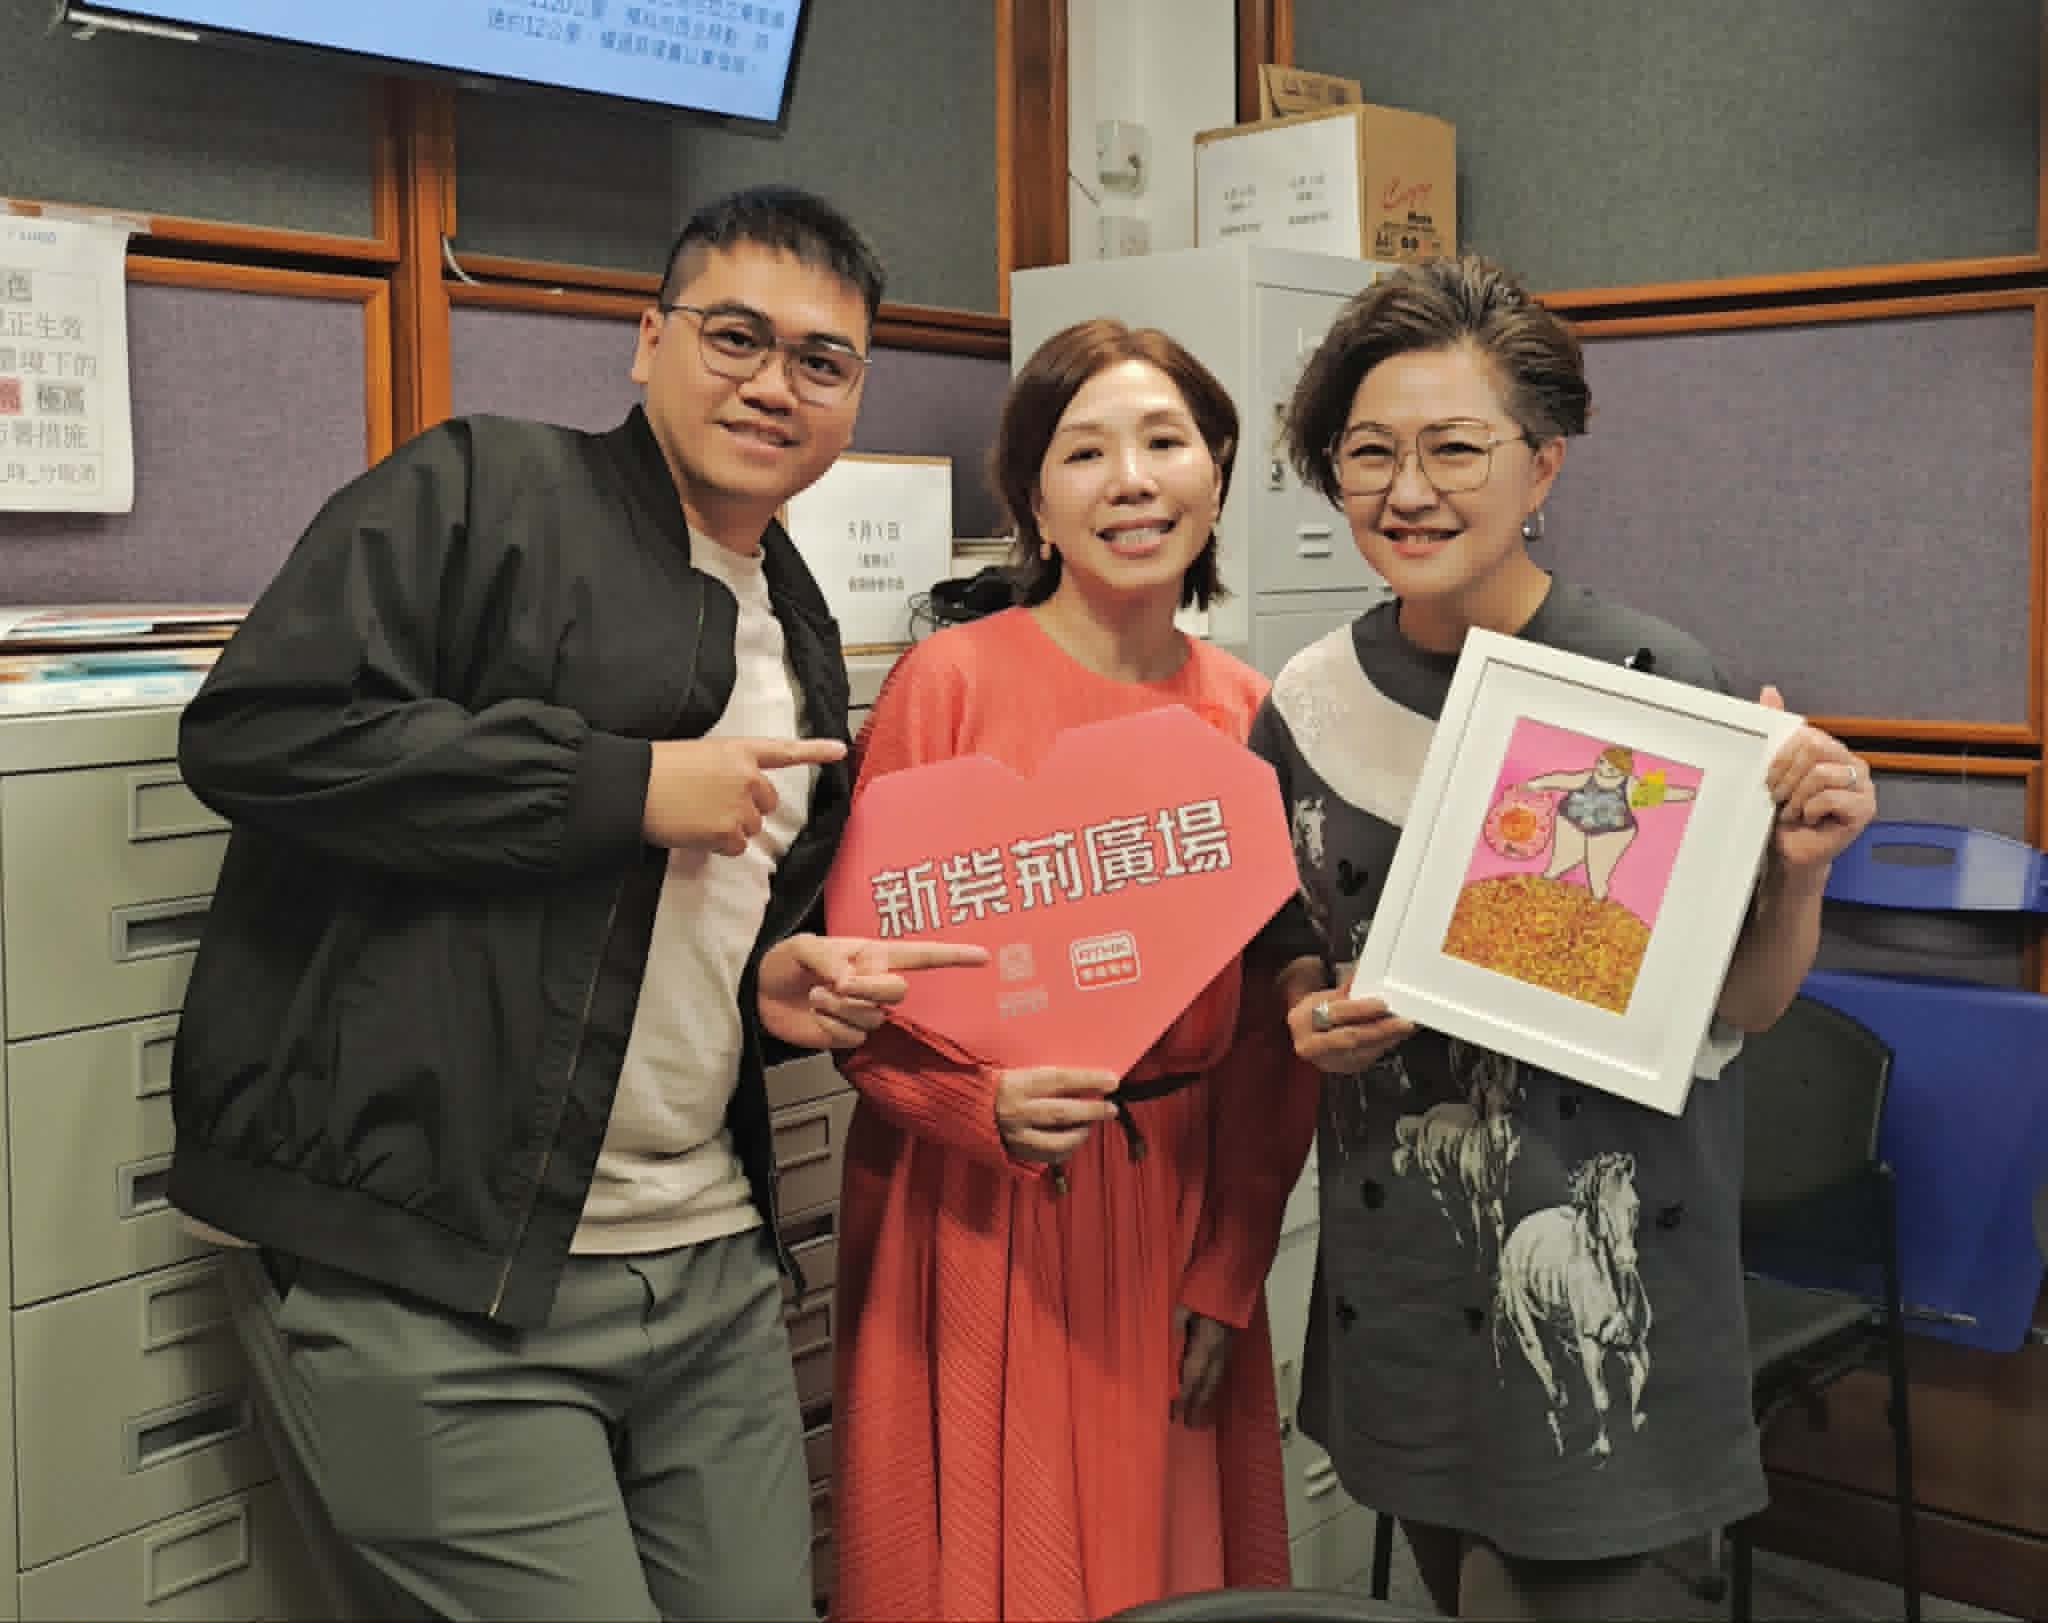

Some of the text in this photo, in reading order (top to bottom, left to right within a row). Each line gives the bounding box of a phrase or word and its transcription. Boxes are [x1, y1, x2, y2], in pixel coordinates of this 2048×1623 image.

[871, 799, 1232, 937] 新紫荊廣場
